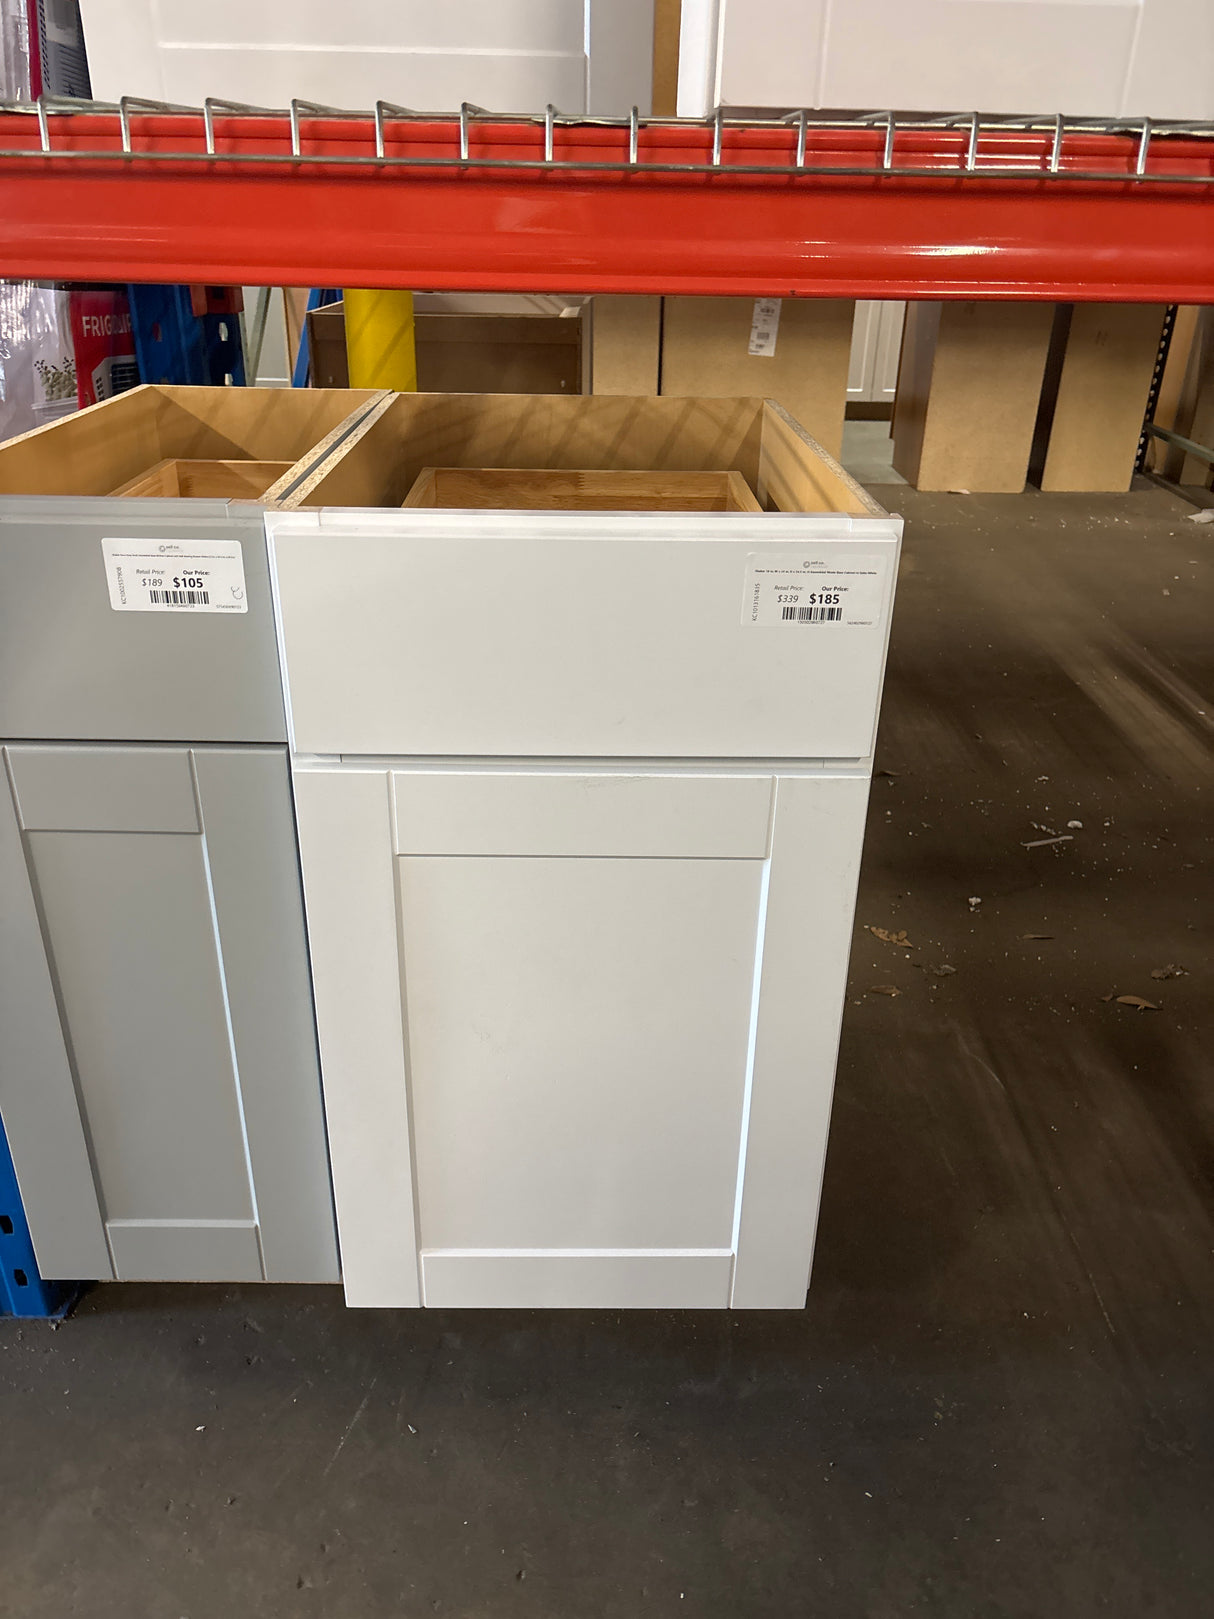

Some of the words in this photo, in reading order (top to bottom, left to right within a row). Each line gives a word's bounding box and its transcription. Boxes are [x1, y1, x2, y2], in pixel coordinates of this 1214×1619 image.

[142, 578, 162, 587] $189
[172, 577, 204, 588] $105
[777, 595, 798, 603] $339
[809, 593, 840, 605] $185
